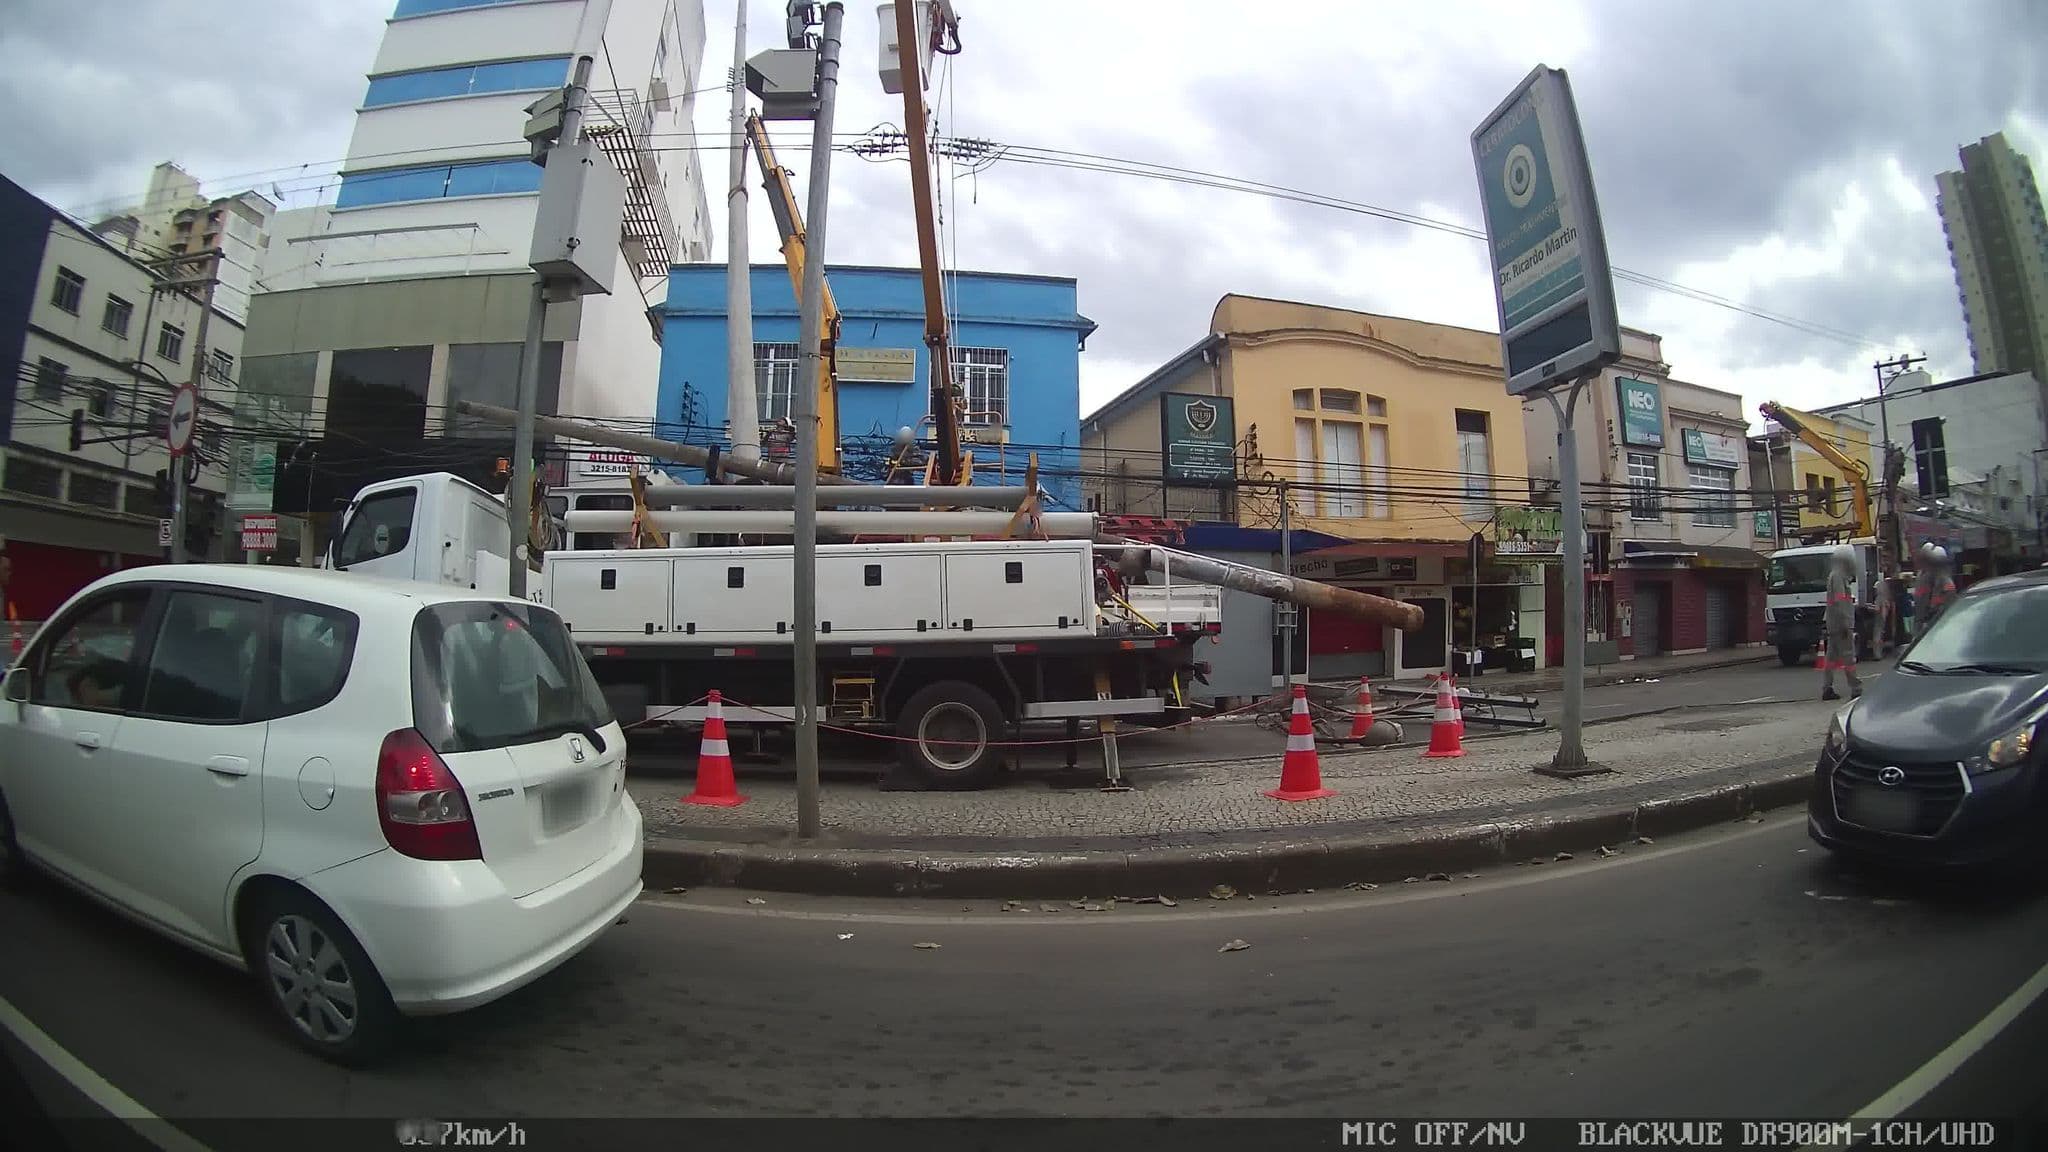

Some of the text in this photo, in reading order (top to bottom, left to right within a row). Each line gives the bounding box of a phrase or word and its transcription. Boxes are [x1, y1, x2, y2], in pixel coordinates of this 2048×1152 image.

[1512, 249, 1544, 278] Ricardo
[1545, 227, 1577, 257] Martin
[1628, 389, 1655, 410] NEO
